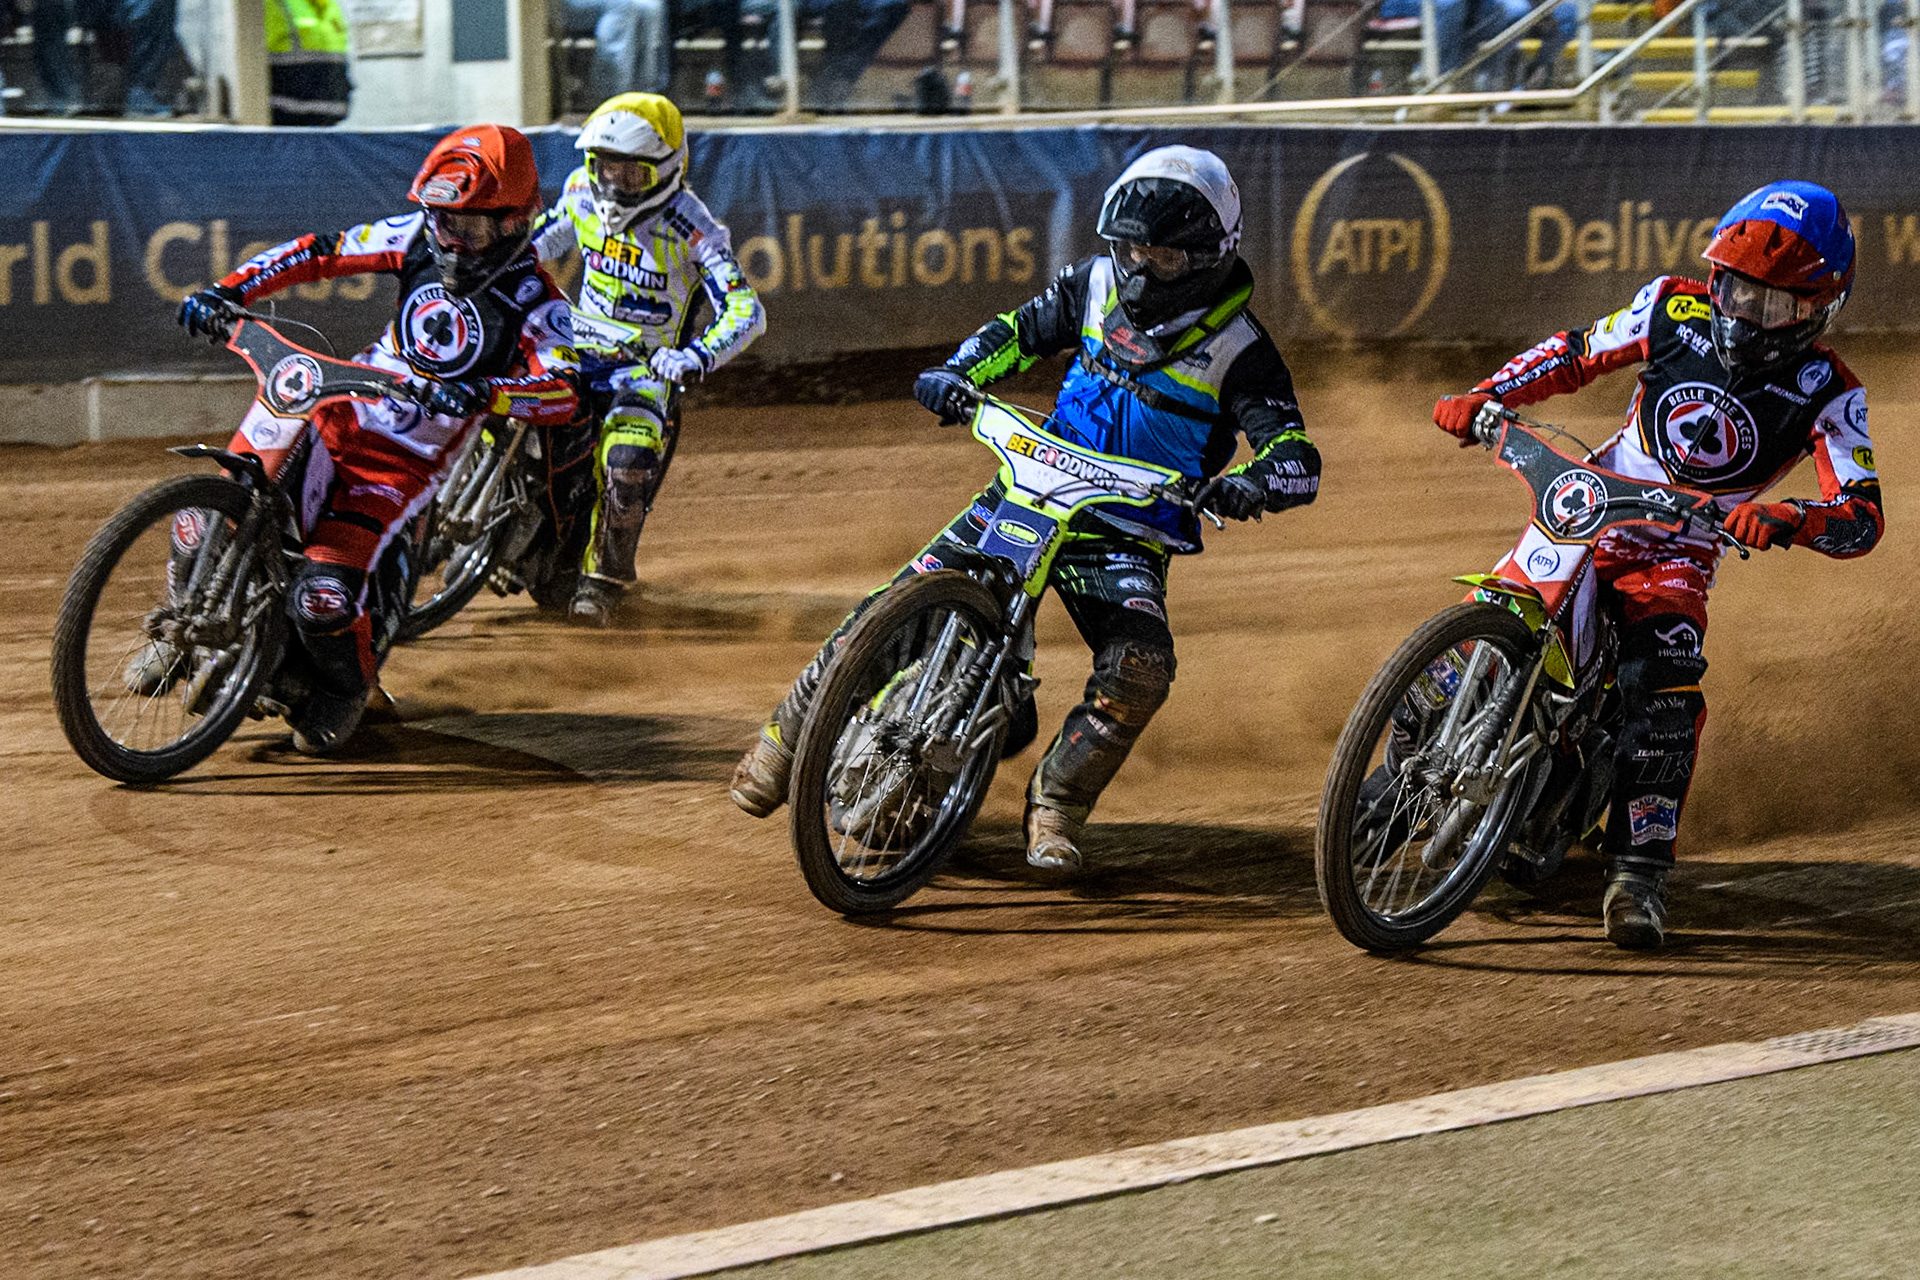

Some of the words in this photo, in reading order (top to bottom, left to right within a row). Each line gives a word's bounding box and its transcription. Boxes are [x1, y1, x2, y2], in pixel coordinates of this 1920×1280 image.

[603, 237, 643, 267] BET
[737, 210, 1037, 294] olutions
[1316, 217, 1423, 277] ATPI
[1675, 322, 1713, 354] ROWE
[1667, 388, 1706, 408] BELLE
[1735, 418, 1752, 451] ACES
[1580, 473, 1597, 486] VUE
[1593, 485, 1605, 502] ACE
[1532, 554, 1556, 571] ATPI
[1658, 647, 1687, 659] HIGH
